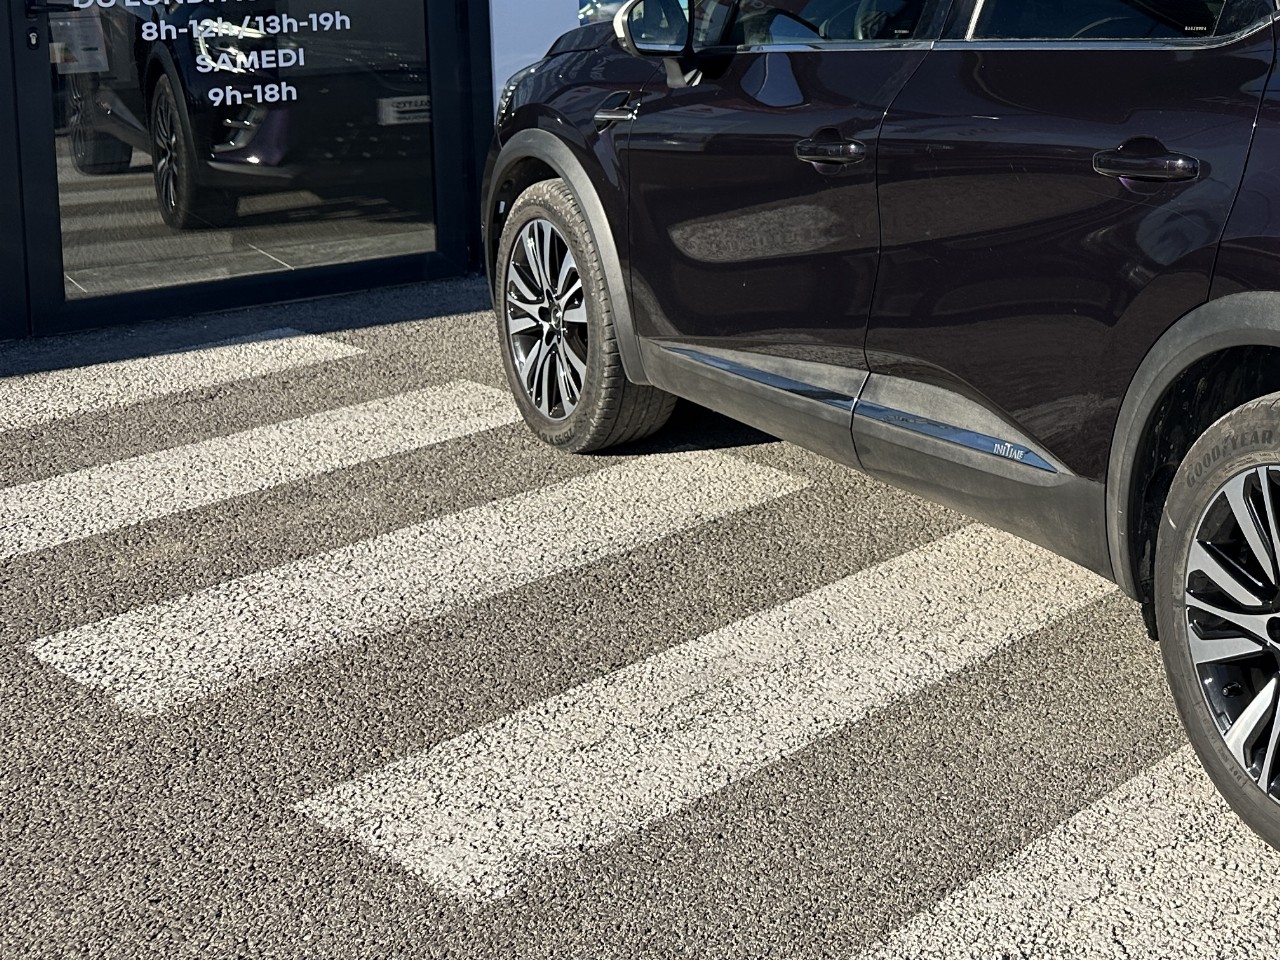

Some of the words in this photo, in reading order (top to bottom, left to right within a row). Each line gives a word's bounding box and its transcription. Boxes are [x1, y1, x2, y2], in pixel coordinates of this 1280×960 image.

[141, 19, 237, 42] 8h-12h
[256, 11, 351, 35] 13h-19h
[195, 48, 305, 74] SAMEDI
[208, 82, 298, 107] 9h-18h
